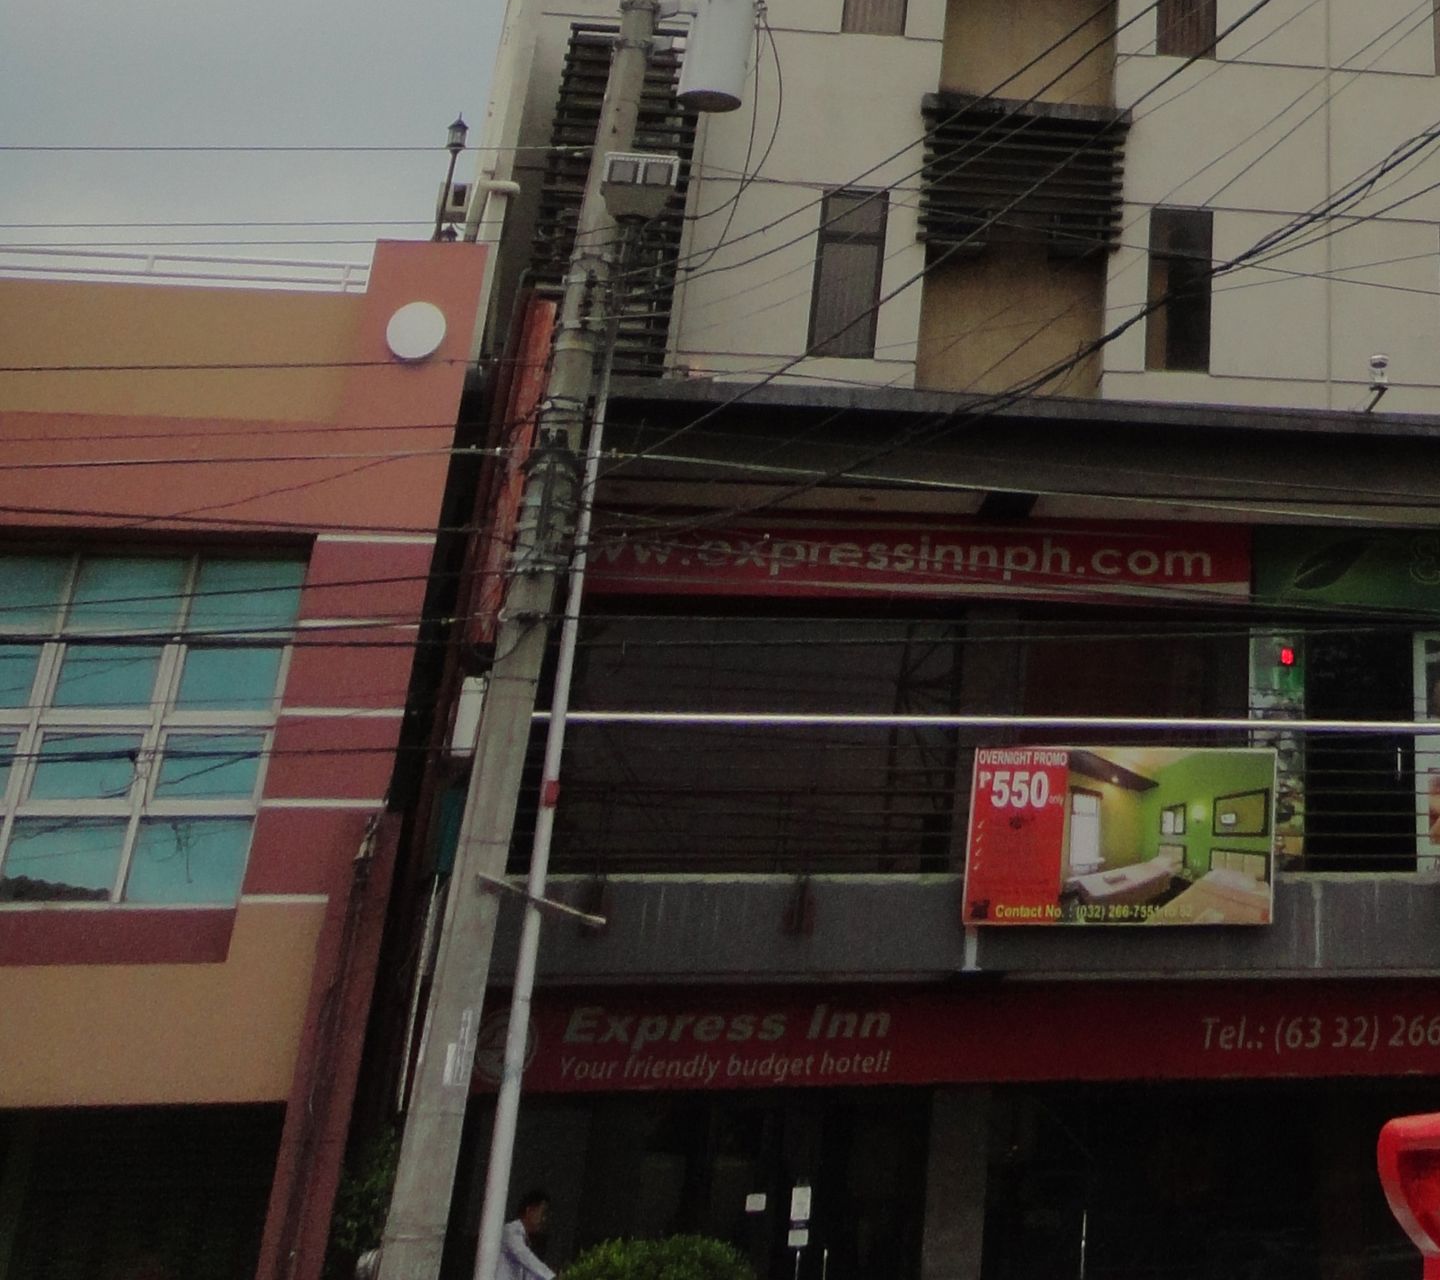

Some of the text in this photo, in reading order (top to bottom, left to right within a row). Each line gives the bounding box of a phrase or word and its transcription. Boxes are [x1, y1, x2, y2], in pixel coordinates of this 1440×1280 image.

[979, 750, 1068, 766] OVERNIGHT PROMO
[995, 904, 1042, 918] Contact
[1076, 904, 1106, 920] (032)
[563, 1005, 892, 1052] Express Inn
[1274, 1015, 1322, 1055] (63
[1331, 1015, 1381, 1052] 32)
[559, 1050, 892, 1087] Your friendly budget hotel!
